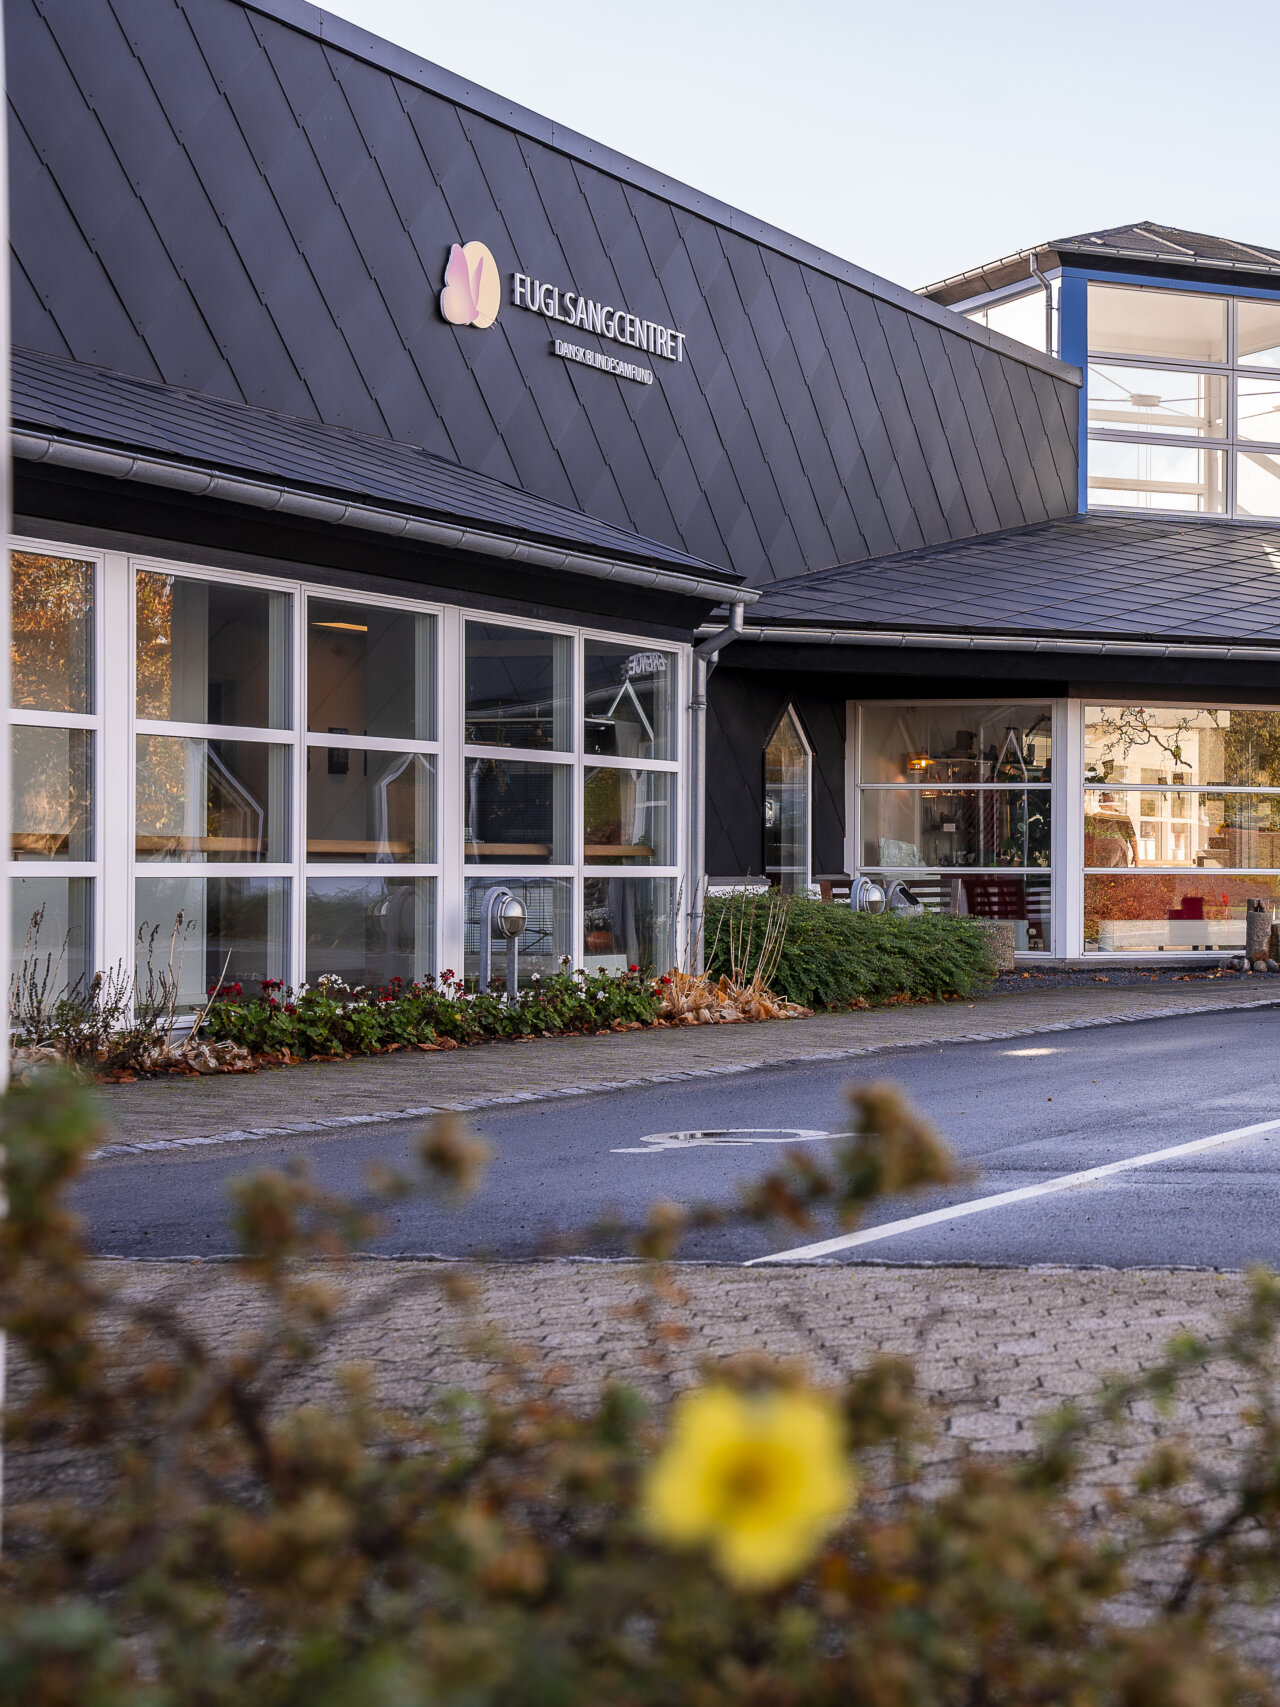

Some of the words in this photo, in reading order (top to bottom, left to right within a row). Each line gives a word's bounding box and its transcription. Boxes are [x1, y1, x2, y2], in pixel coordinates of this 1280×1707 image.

[514, 273, 686, 362] FUGLSANGCENTRET
[555, 339, 586, 363] DANSK
[585, 349, 653, 384] BLINDESAMFUND
